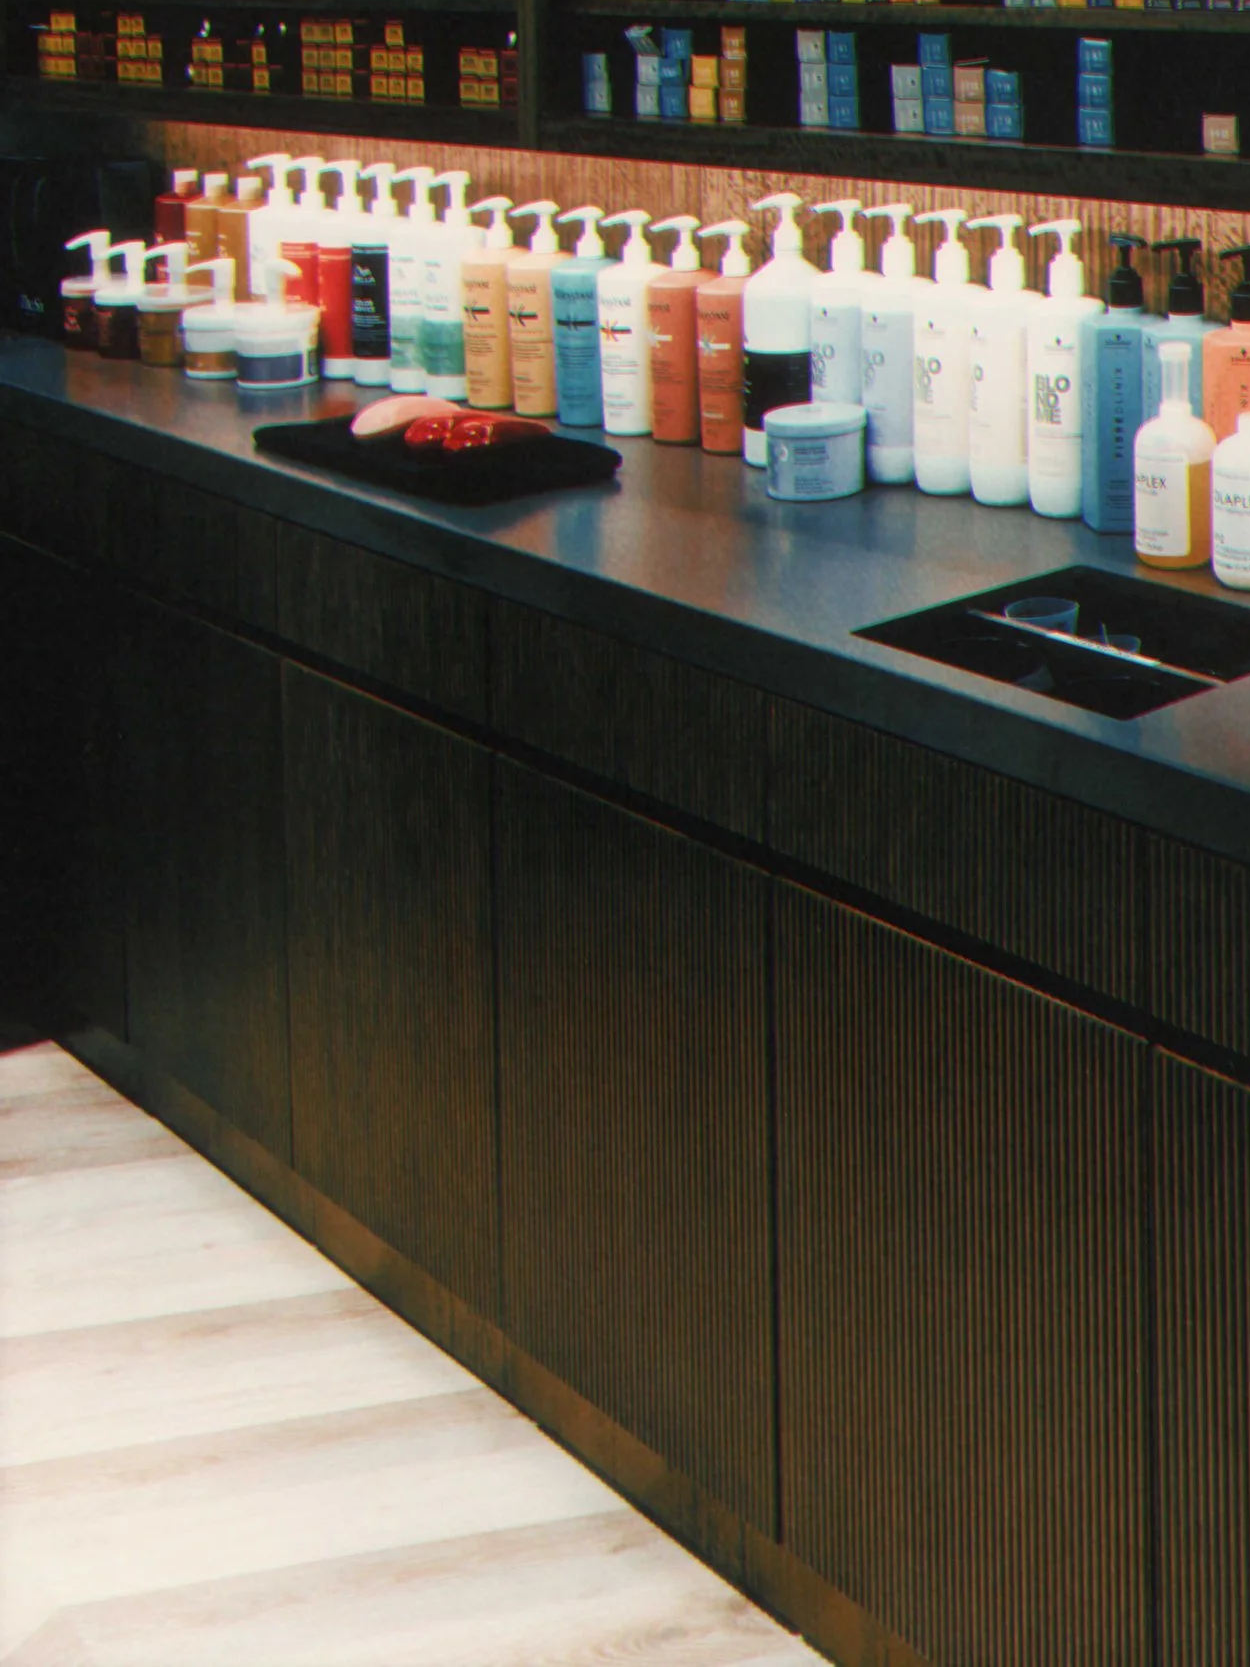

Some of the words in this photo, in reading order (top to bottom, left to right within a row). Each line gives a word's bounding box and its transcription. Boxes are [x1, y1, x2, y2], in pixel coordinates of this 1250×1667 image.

[1035, 374, 1071, 393] BLO
[1035, 393, 1060, 409] ND
[1035, 408, 1062, 425] ME
